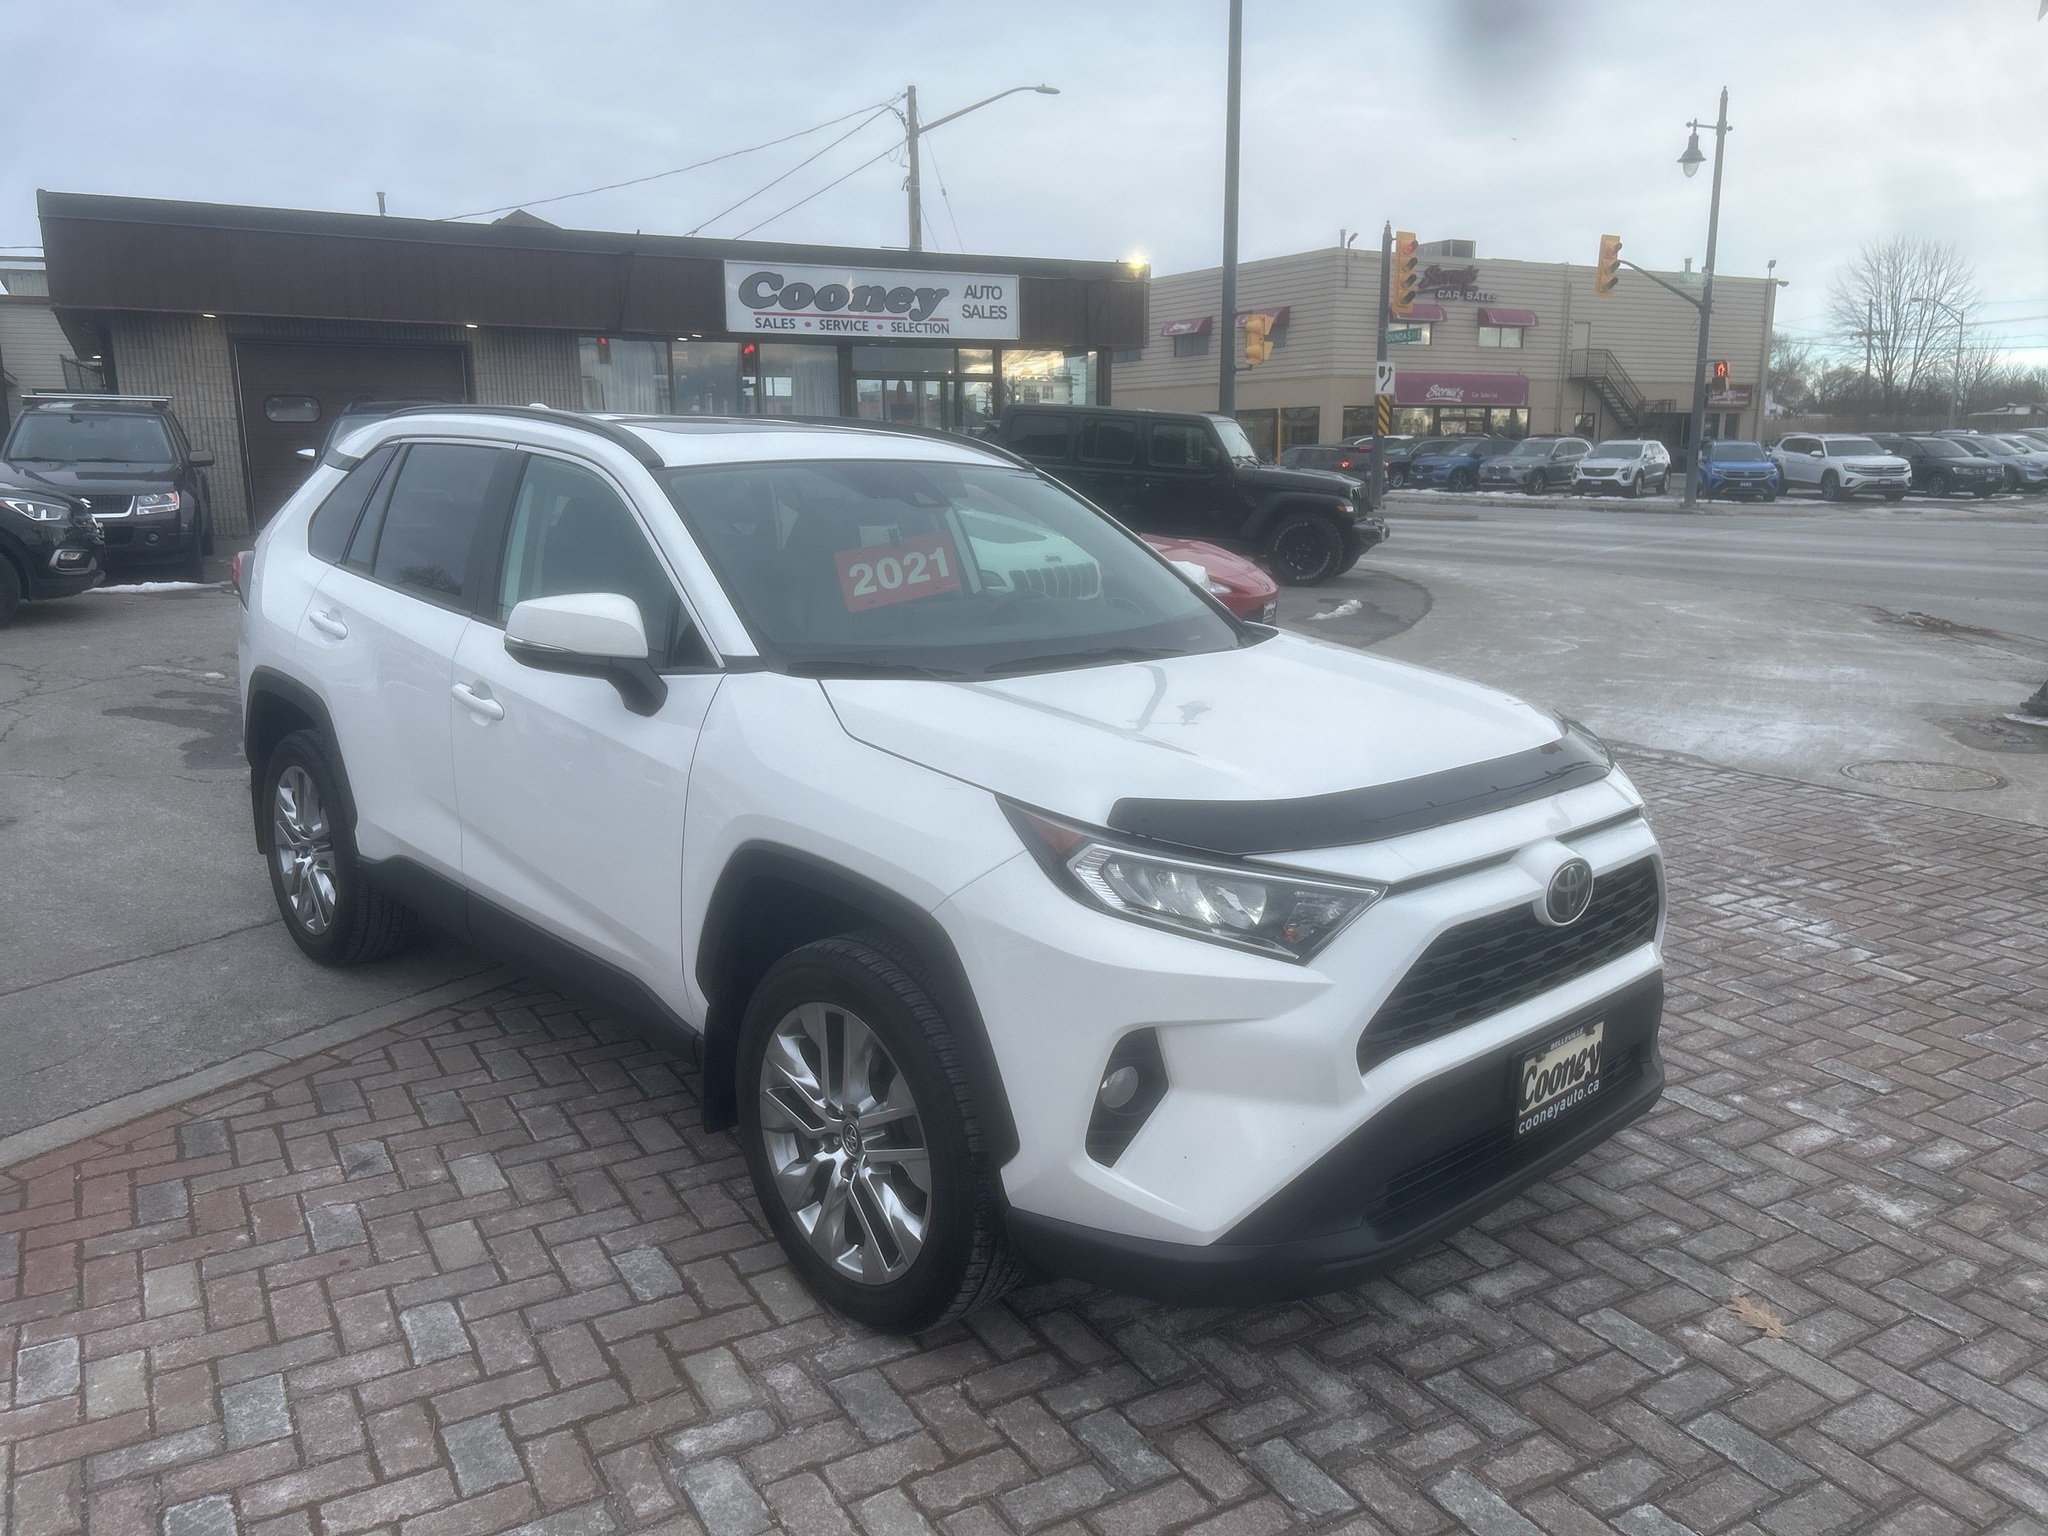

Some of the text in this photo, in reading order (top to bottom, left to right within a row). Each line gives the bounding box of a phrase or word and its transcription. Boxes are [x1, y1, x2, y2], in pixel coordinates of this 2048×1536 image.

[738, 271, 949, 322] Cooney
[963, 284, 1003, 300] AUTO
[1437, 290, 1498, 301] CAR SALES
[961, 304, 1007, 320] SALES
[754, 317, 949, 334] SALES SERVICE SELECTION
[1387, 330, 1411, 342] DUNDAS
[849, 546, 949, 596] 2021
[1550, 1027, 1584, 1050] BELLEVILLE
[1520, 1040, 1602, 1112] Cooney
[1518, 1079, 1600, 1134] cooneyauto.ca
